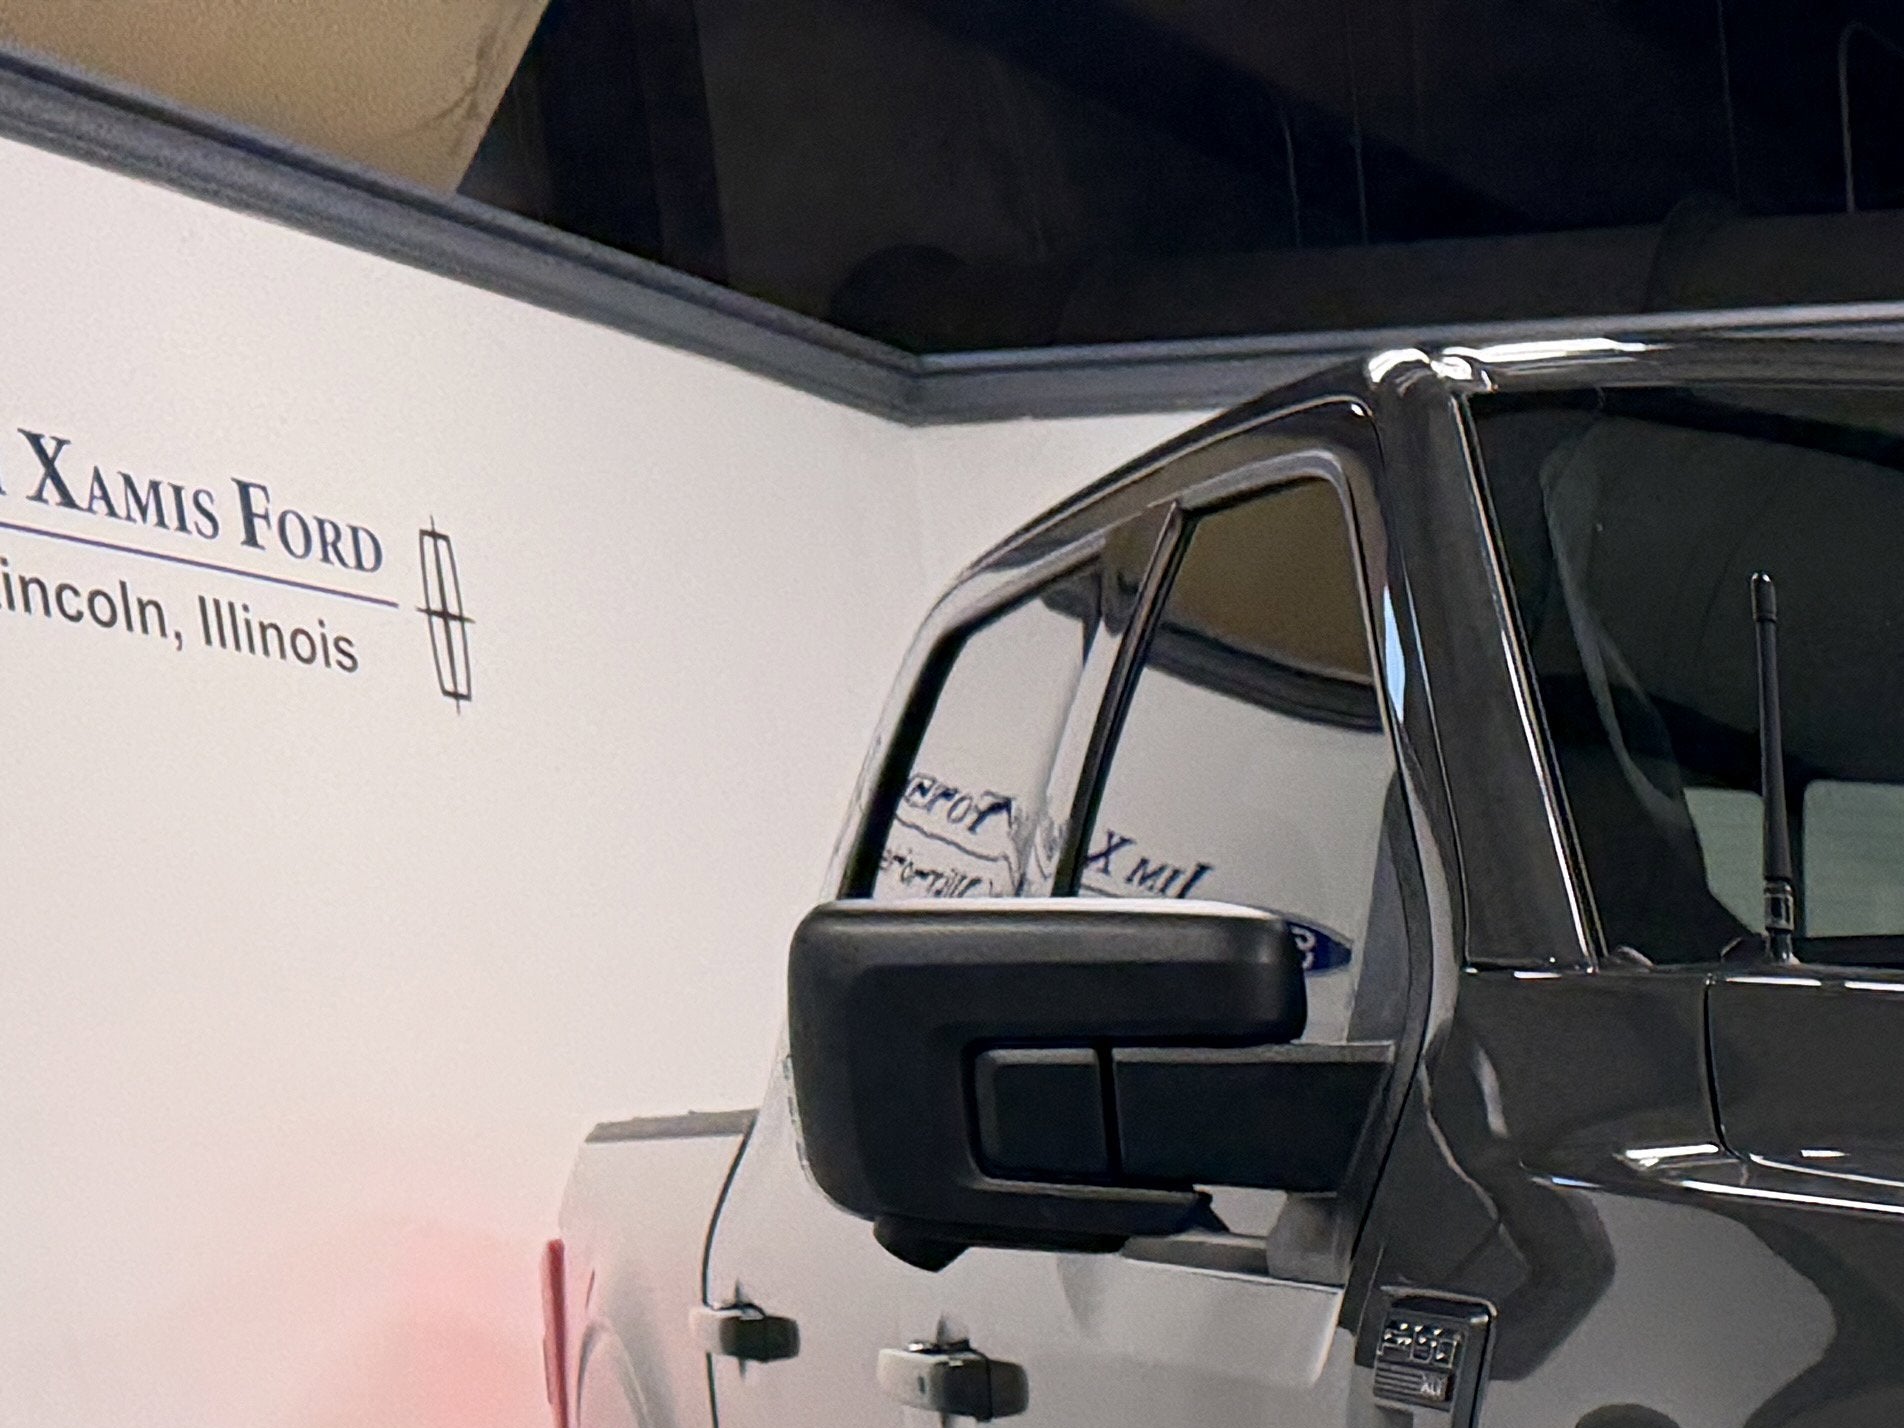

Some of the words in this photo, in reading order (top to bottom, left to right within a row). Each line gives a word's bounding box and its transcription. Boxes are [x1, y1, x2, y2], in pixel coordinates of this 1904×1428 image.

[17, 427, 221, 541] XAMIS
[230, 475, 384, 574] FORD
[0, 556, 184, 652] incoln,
[197, 593, 360, 674] Illinois
